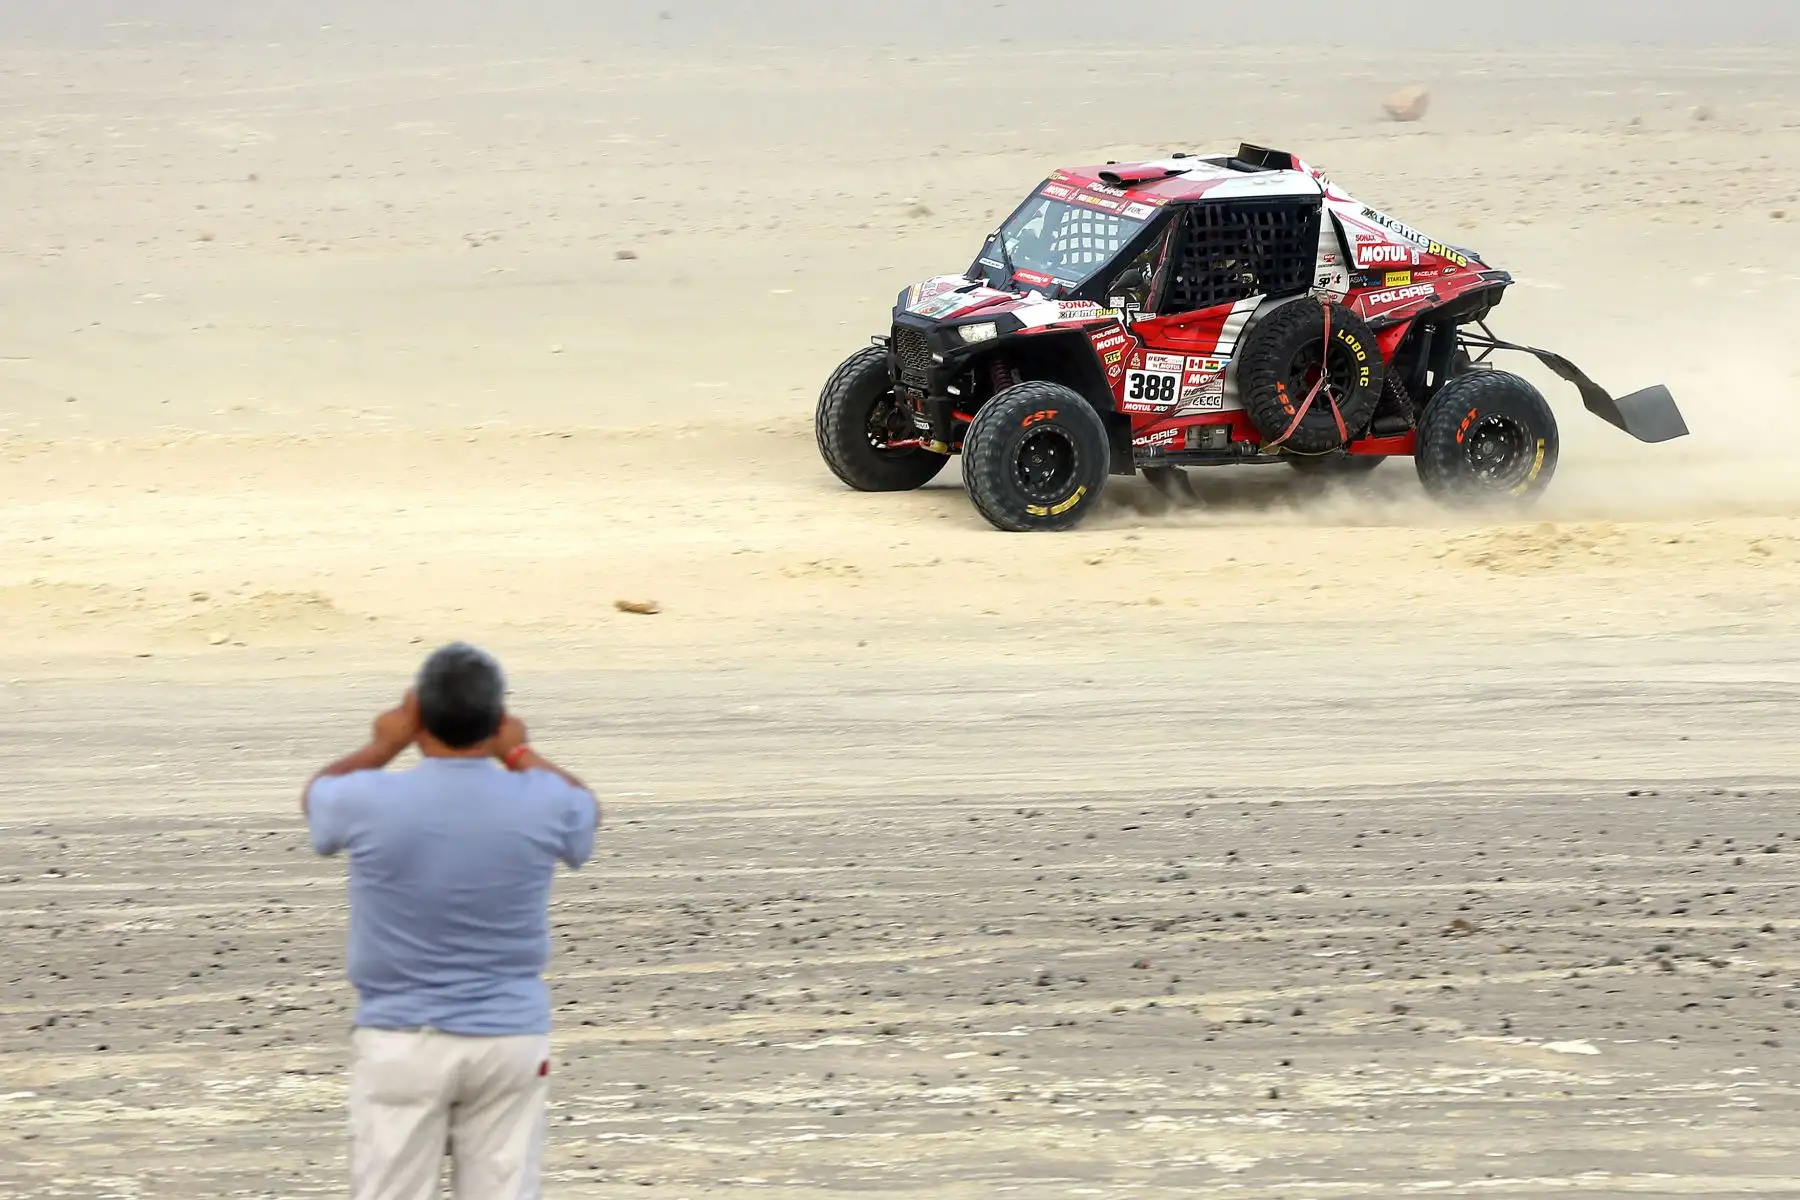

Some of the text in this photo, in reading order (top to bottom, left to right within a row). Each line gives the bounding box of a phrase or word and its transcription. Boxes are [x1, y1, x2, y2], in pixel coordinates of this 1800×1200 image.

[1360, 246, 1408, 263] MOTUL
[1413, 270, 1439, 278] RACELINE
[1368, 283, 1435, 305] POLARIS
[1057, 300, 1095, 310] SONAX
[1091, 326, 1121, 340] POLARIS
[1096, 334, 1126, 351] MOTUL
[1337, 329, 1369, 387] LOBO RC
[1160, 363, 1181, 371] MOTUL
[1129, 373, 1176, 402] 388
[1275, 381, 1296, 415] CST
[1124, 403, 1151, 411] MOTUL
[1021, 410, 1059, 428] CST
